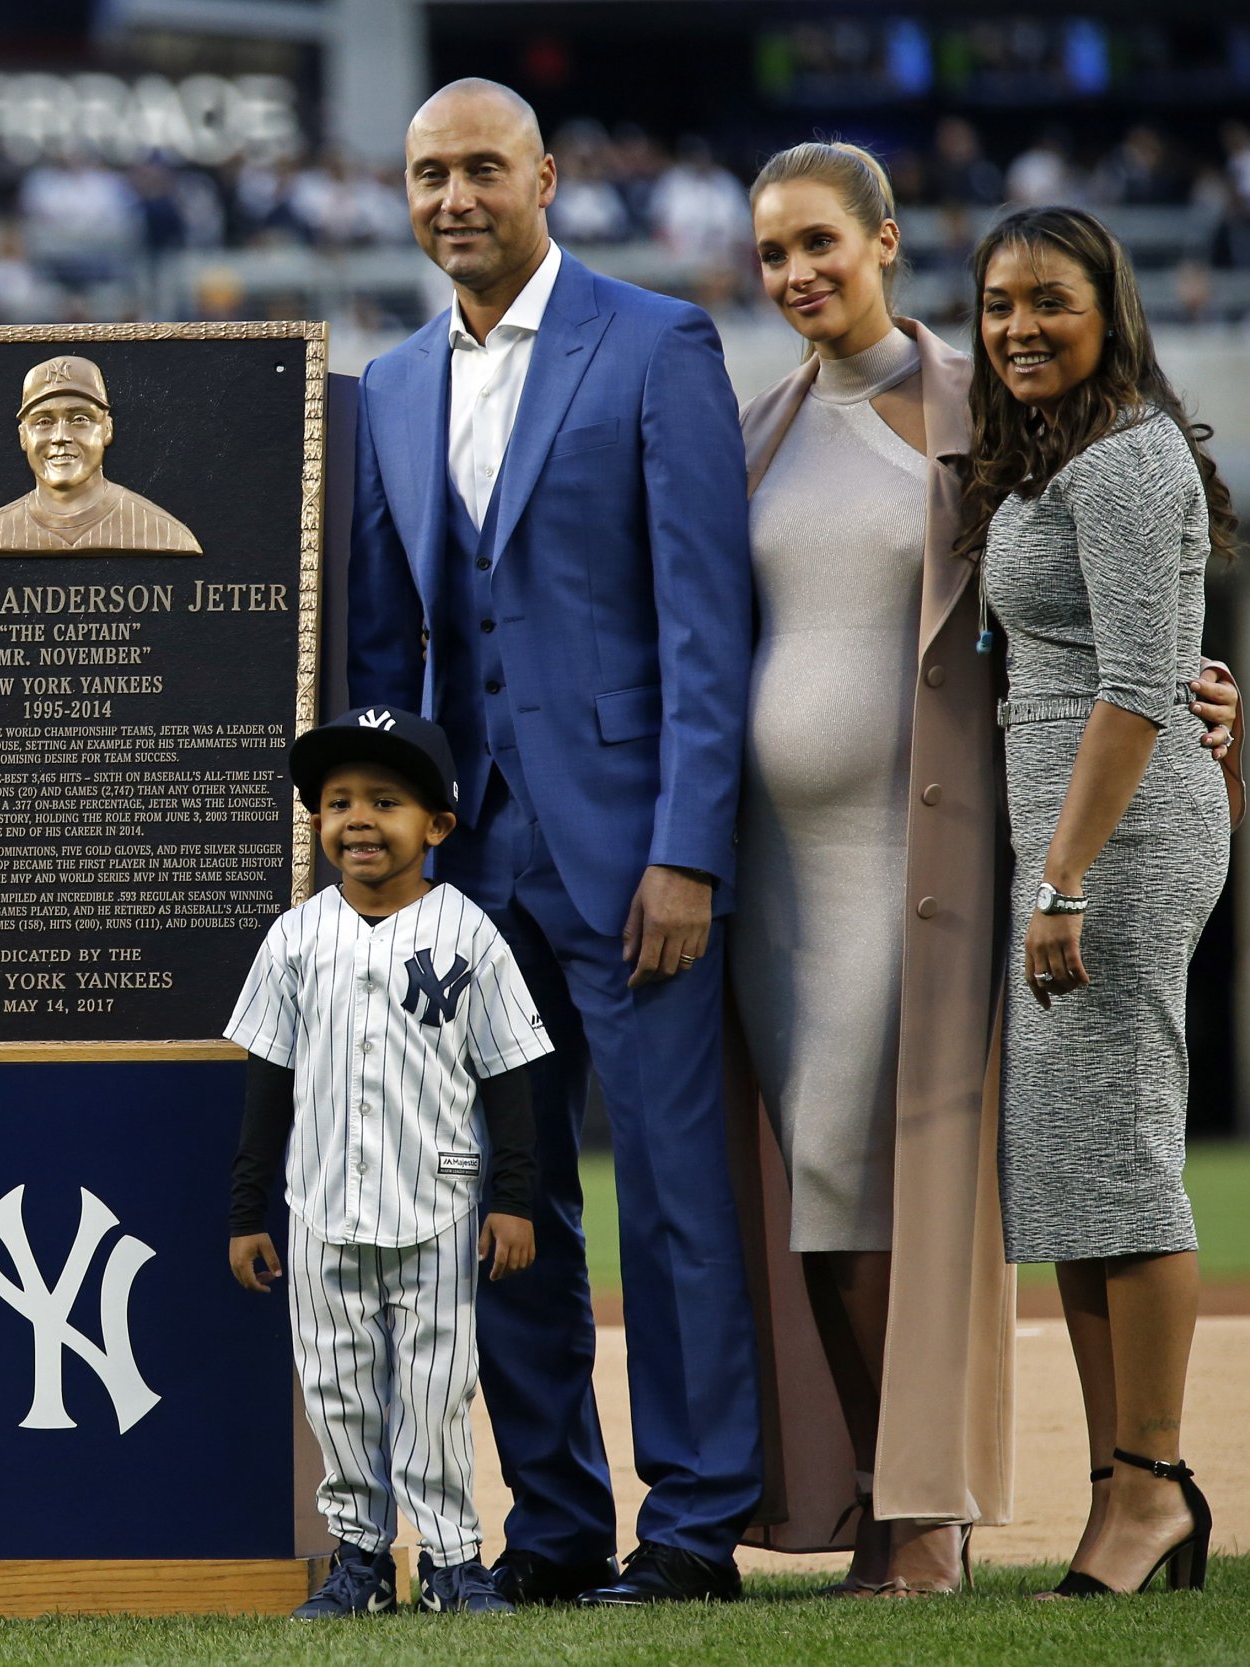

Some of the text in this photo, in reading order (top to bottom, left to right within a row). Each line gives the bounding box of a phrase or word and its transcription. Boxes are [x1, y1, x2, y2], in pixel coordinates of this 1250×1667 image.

[188, 579, 287, 611] JETER
[22, 677, 70, 694] YORK
[80, 676, 162, 693] YANKEES
[24, 700, 110, 718] 1995-2014
[5, 727, 41, 737] WORLD
[44, 726, 117, 736] CHAMPIONSHIP
[120, 726, 155, 736] TEAMS,
[160, 725, 188, 734] JETER
[192, 725, 212, 734] WAS
[216, 725, 223, 734] A
[227, 724, 264, 734] LEADER
[268, 724, 282, 733] ON
[25, 740, 66, 749] SETTING
[70, 739, 83, 749] AN
[87, 739, 132, 749] EXAMPLE
[136, 739, 154, 748] FOR
[158, 739, 174, 748] HIS
[177, 738, 236, 748] TEAMMATES
[241, 738, 266, 747] WITH
[270, 738, 285, 747] HIS
[45, 753, 77, 762] DESIRE
[81, 753, 100, 762] FOR
[104, 752, 131, 762] TEAM
[135, 752, 178, 762] SUCCESS.
[18, 786, 36, 798] (20)
[40, 786, 61, 795] AND
[65, 786, 97, 795] GAMES
[101, 785, 133, 797] (2,747)
[137, 785, 164, 794] THAN
[168, 785, 188, 794] ANY
[192, 784, 225, 794] OTHER
[229, 784, 269, 793] YANKEE.
[2, 800, 8, 809] A
[13, 800, 31, 809] .377
[35, 799, 76, 809] ON-BASE
[80, 798, 144, 810] PERCENTAGE,
[148, 798, 177, 808] JETER
[181, 798, 201, 807] WAS
[205, 798, 224, 807] THE
[228, 797, 276, 808] LONGEST-
[6, 827, 25, 836] END
[29, 827, 42, 836] OF
[45, 826, 60, 836] HIS
[64, 826, 102, 835] CAREER
[105, 826, 115, 835] IN
[119, 825, 143, 835] 2014.
[62, 846, 81, 855] FIVE
[85, 845, 111, 854] GOLD
[114, 845, 153, 856] GLOVES,
[157, 845, 177, 854] AND
[180, 844, 200, 854] FIVE
[204, 844, 235, 854] SILVER
[239, 844, 281, 853] SLUGGER
[13, 859, 52, 869] BECAME
[56, 859, 75, 868] THE
[79, 859, 105, 868] FIRST
[109, 858, 145, 868] PLAYER
[149, 858, 159, 867] IN
[162, 858, 196, 867] MAJOR
[200, 858, 237, 867] LEAGUE
[241, 857, 283, 867] HISTORY
[40, 892, 53, 901] AN
[57, 892, 113, 902] INCREDIBLE
[117, 891, 136, 901] .593
[140, 891, 184, 900] REGULAR
[188, 890, 225, 900] SEASON
[230, 890, 272, 900] WINNING
[30, 906, 69, 916] PLAYED,
[73, 906, 94, 914] AND
[98, 905, 110, 914] HE
[114, 905, 155, 914] RETIRED
[158, 904, 170, 914] AS
[234, 904, 280, 916] ALL-TIME
[19, 919, 45, 931] (158),
[50, 919, 71, 928] HITS
[75, 918, 102, 930] (200),
[106, 918, 131, 928] RUNS
[135, 918, 162, 930] (111),
[166, 918, 186, 927] AND
[190, 917, 234, 927] DOUBLES
[238, 917, 260, 928] (32).
[79, 949, 100, 960] BY
[109, 948, 140, 960] THE
[5, 973, 65, 989] YORK
[76, 971, 172, 988] YANKEES
[400, 947, 472, 1028] NY
[4, 998, 113, 1013] MAY 14, 2017
[452, 1158, 478, 1167] Majestic
